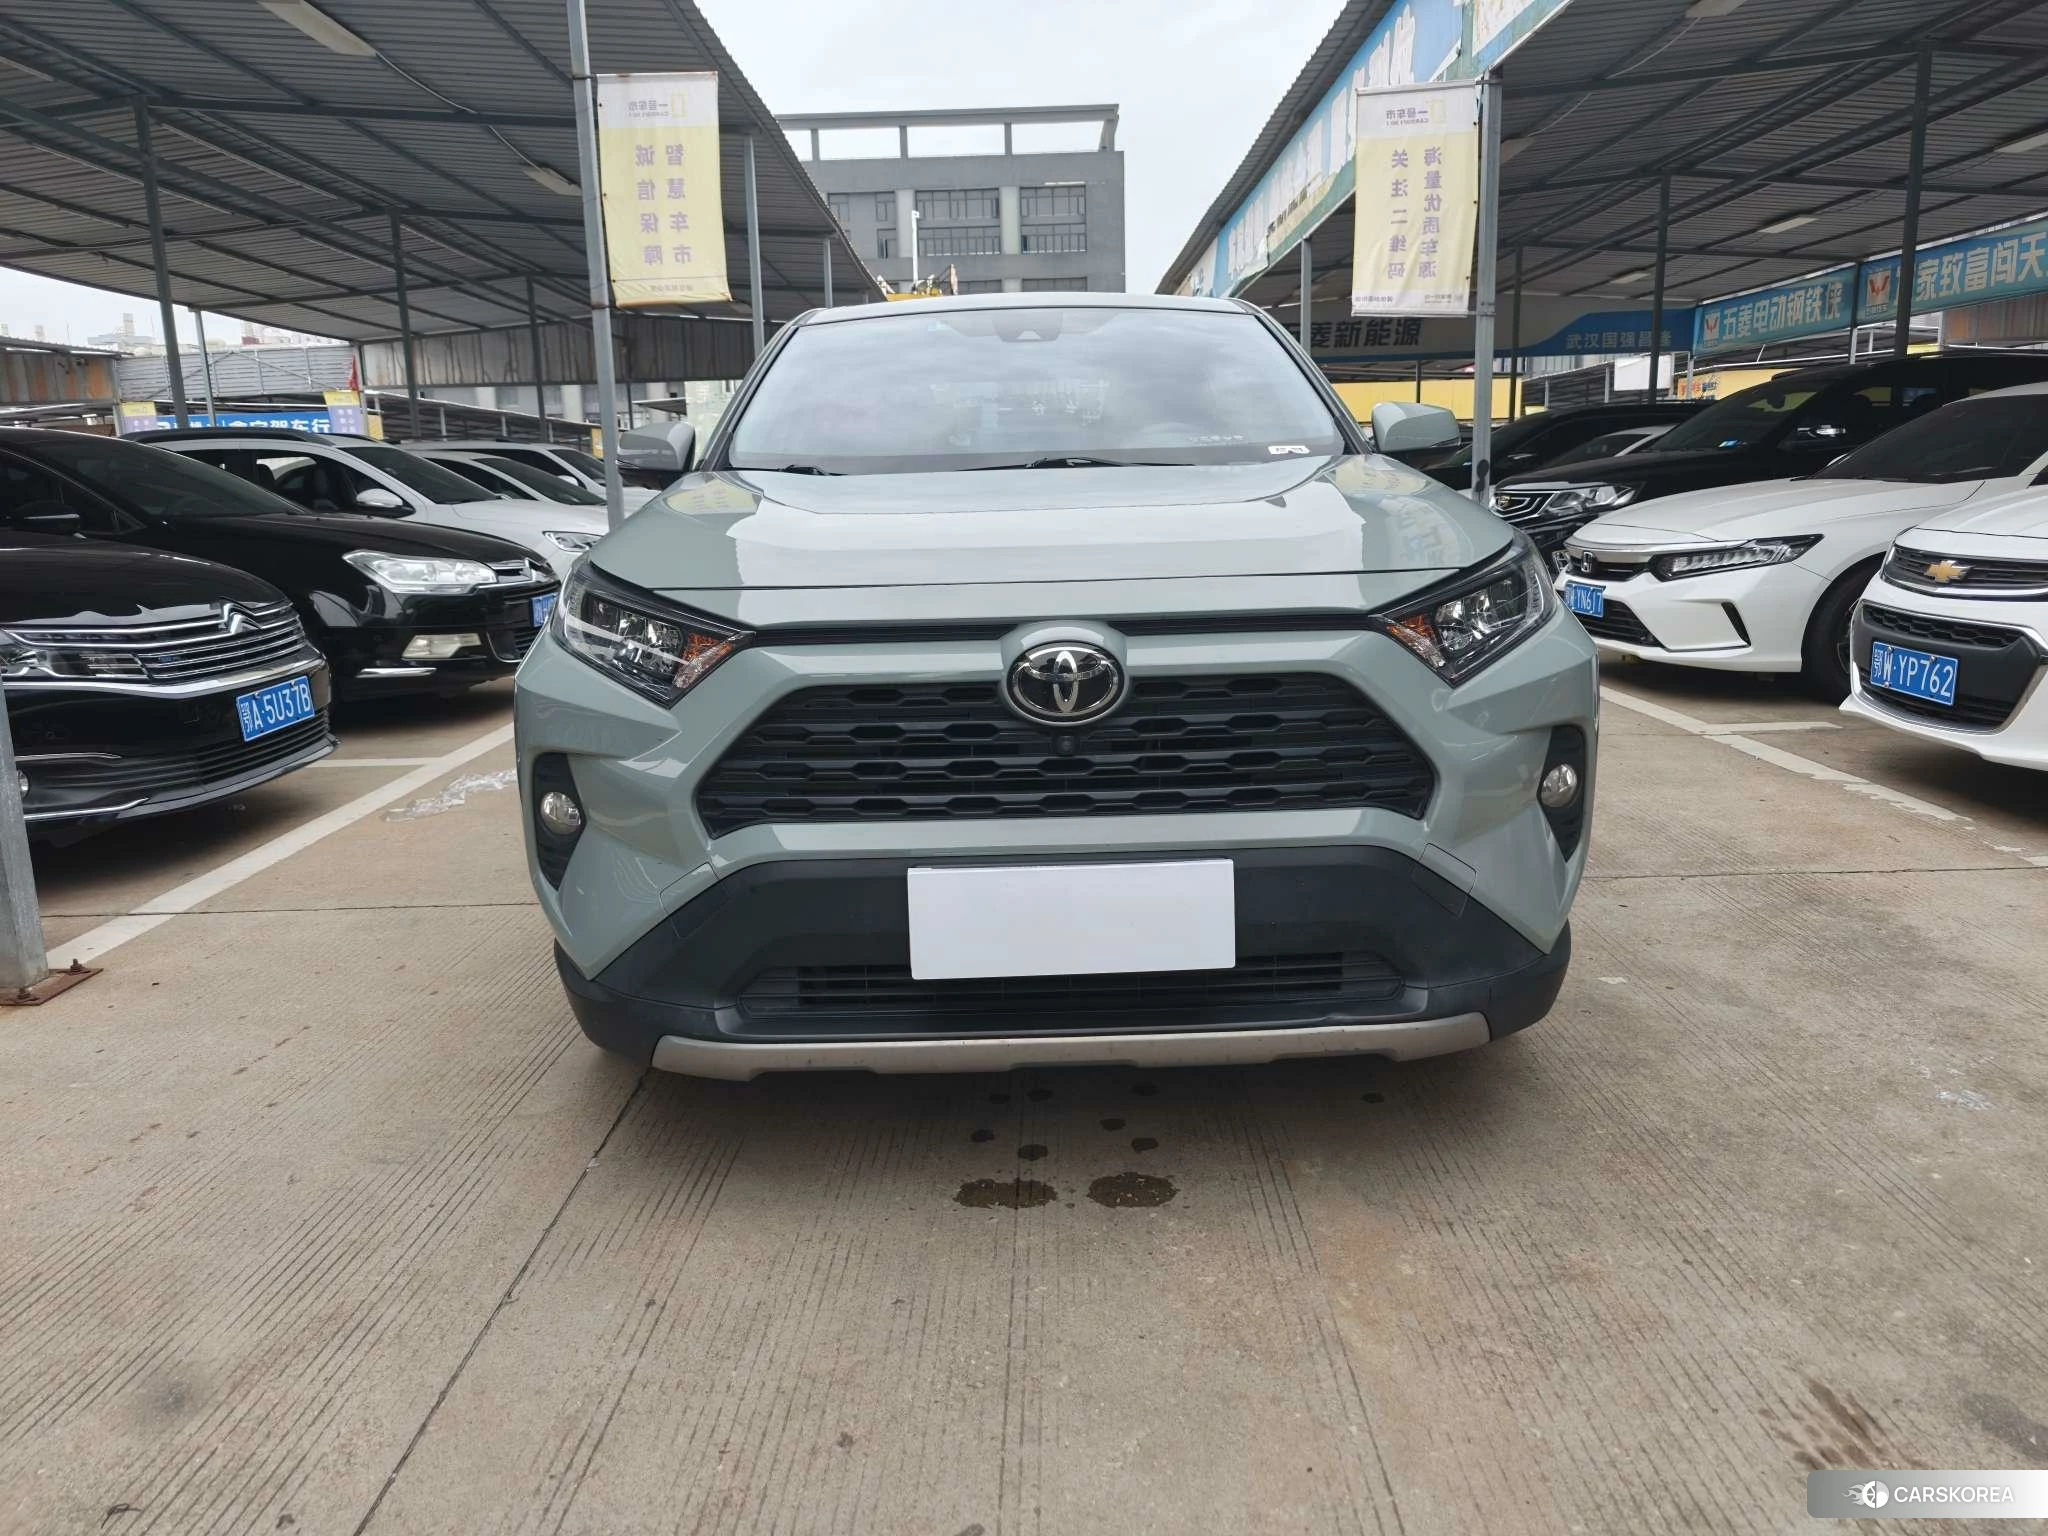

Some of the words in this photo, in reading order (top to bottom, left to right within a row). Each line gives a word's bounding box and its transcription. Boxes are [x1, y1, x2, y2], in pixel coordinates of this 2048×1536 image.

[1895, 232, 2047, 305] 家致富闯天
[1722, 281, 1843, 340] 五菱电动钢铁侠
